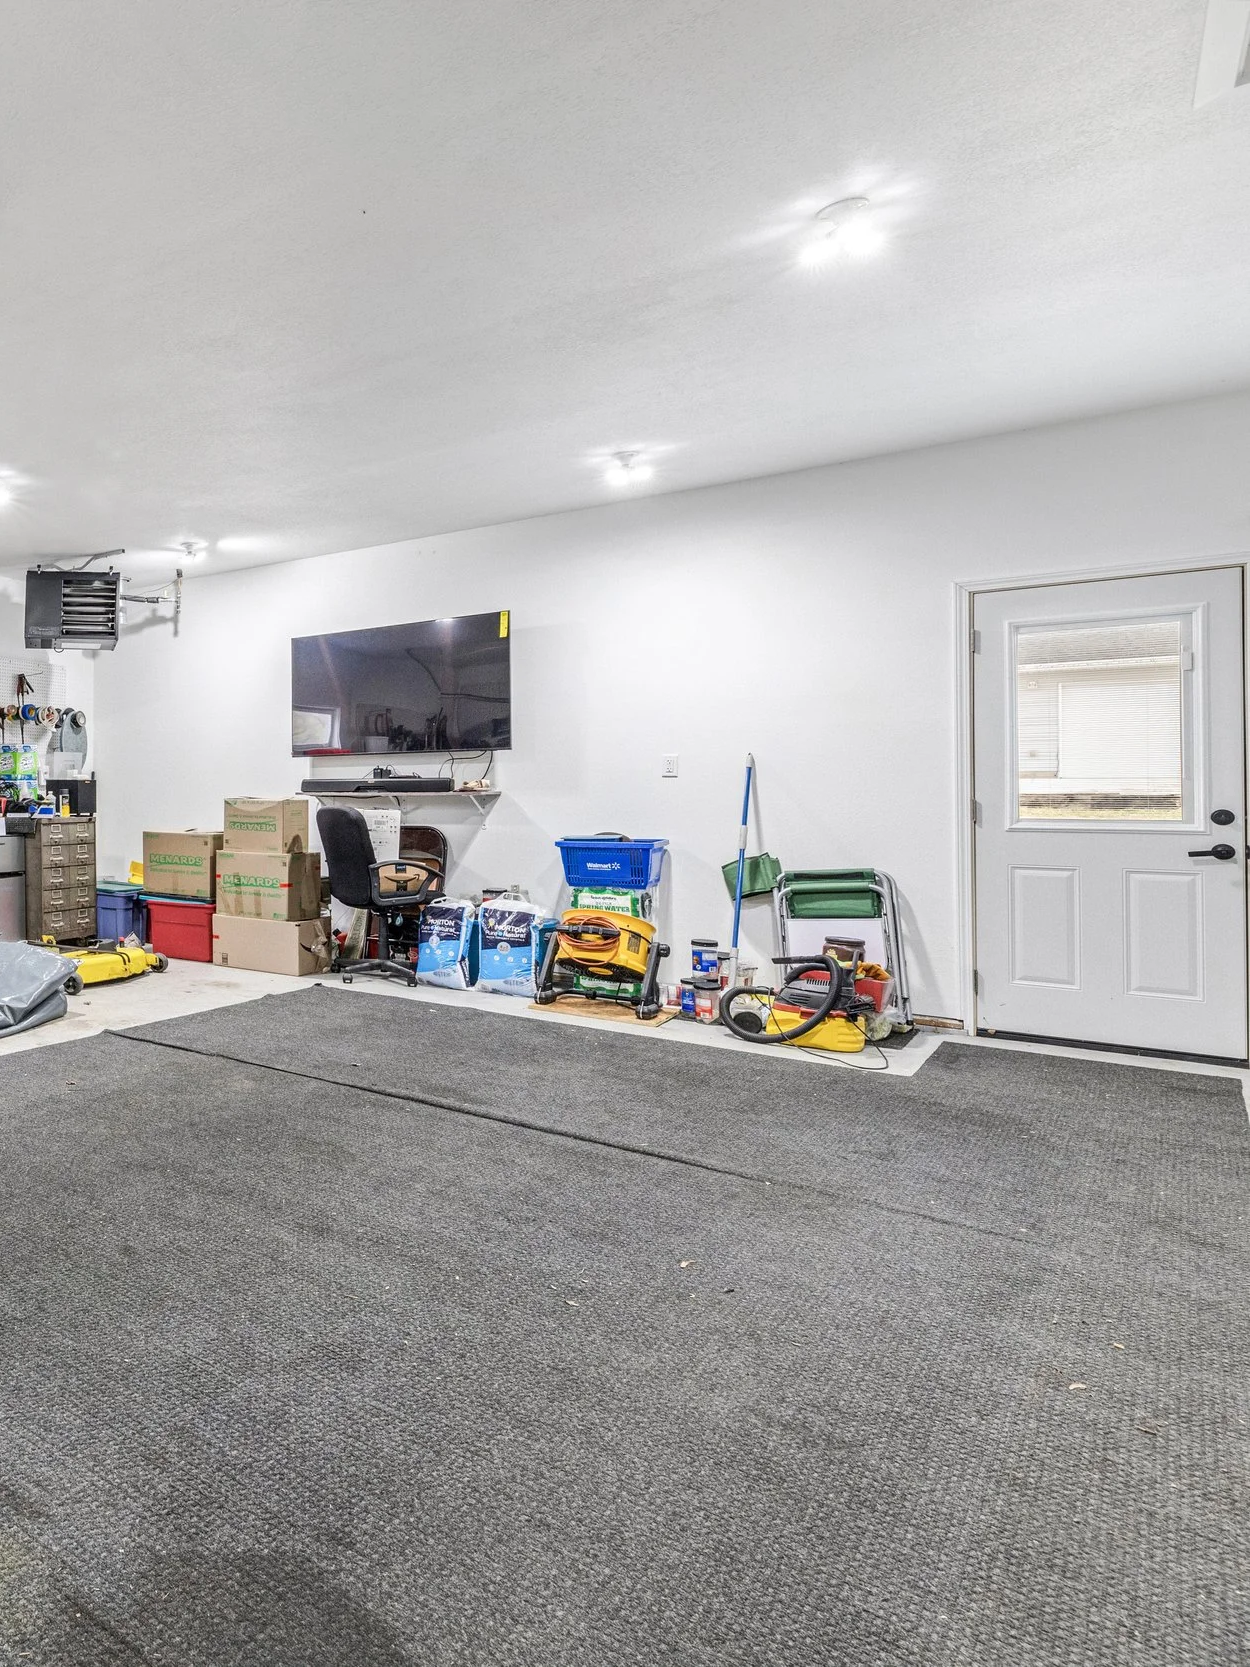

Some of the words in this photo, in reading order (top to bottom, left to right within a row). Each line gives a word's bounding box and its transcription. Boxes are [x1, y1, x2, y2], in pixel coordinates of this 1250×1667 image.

[229, 821, 277, 832] MENARDS
[149, 853, 203, 867] MENARDS
[222, 874, 280, 889] MENARDS
[427, 918, 455, 927] MORTON
[494, 923, 527, 933] MORTON
